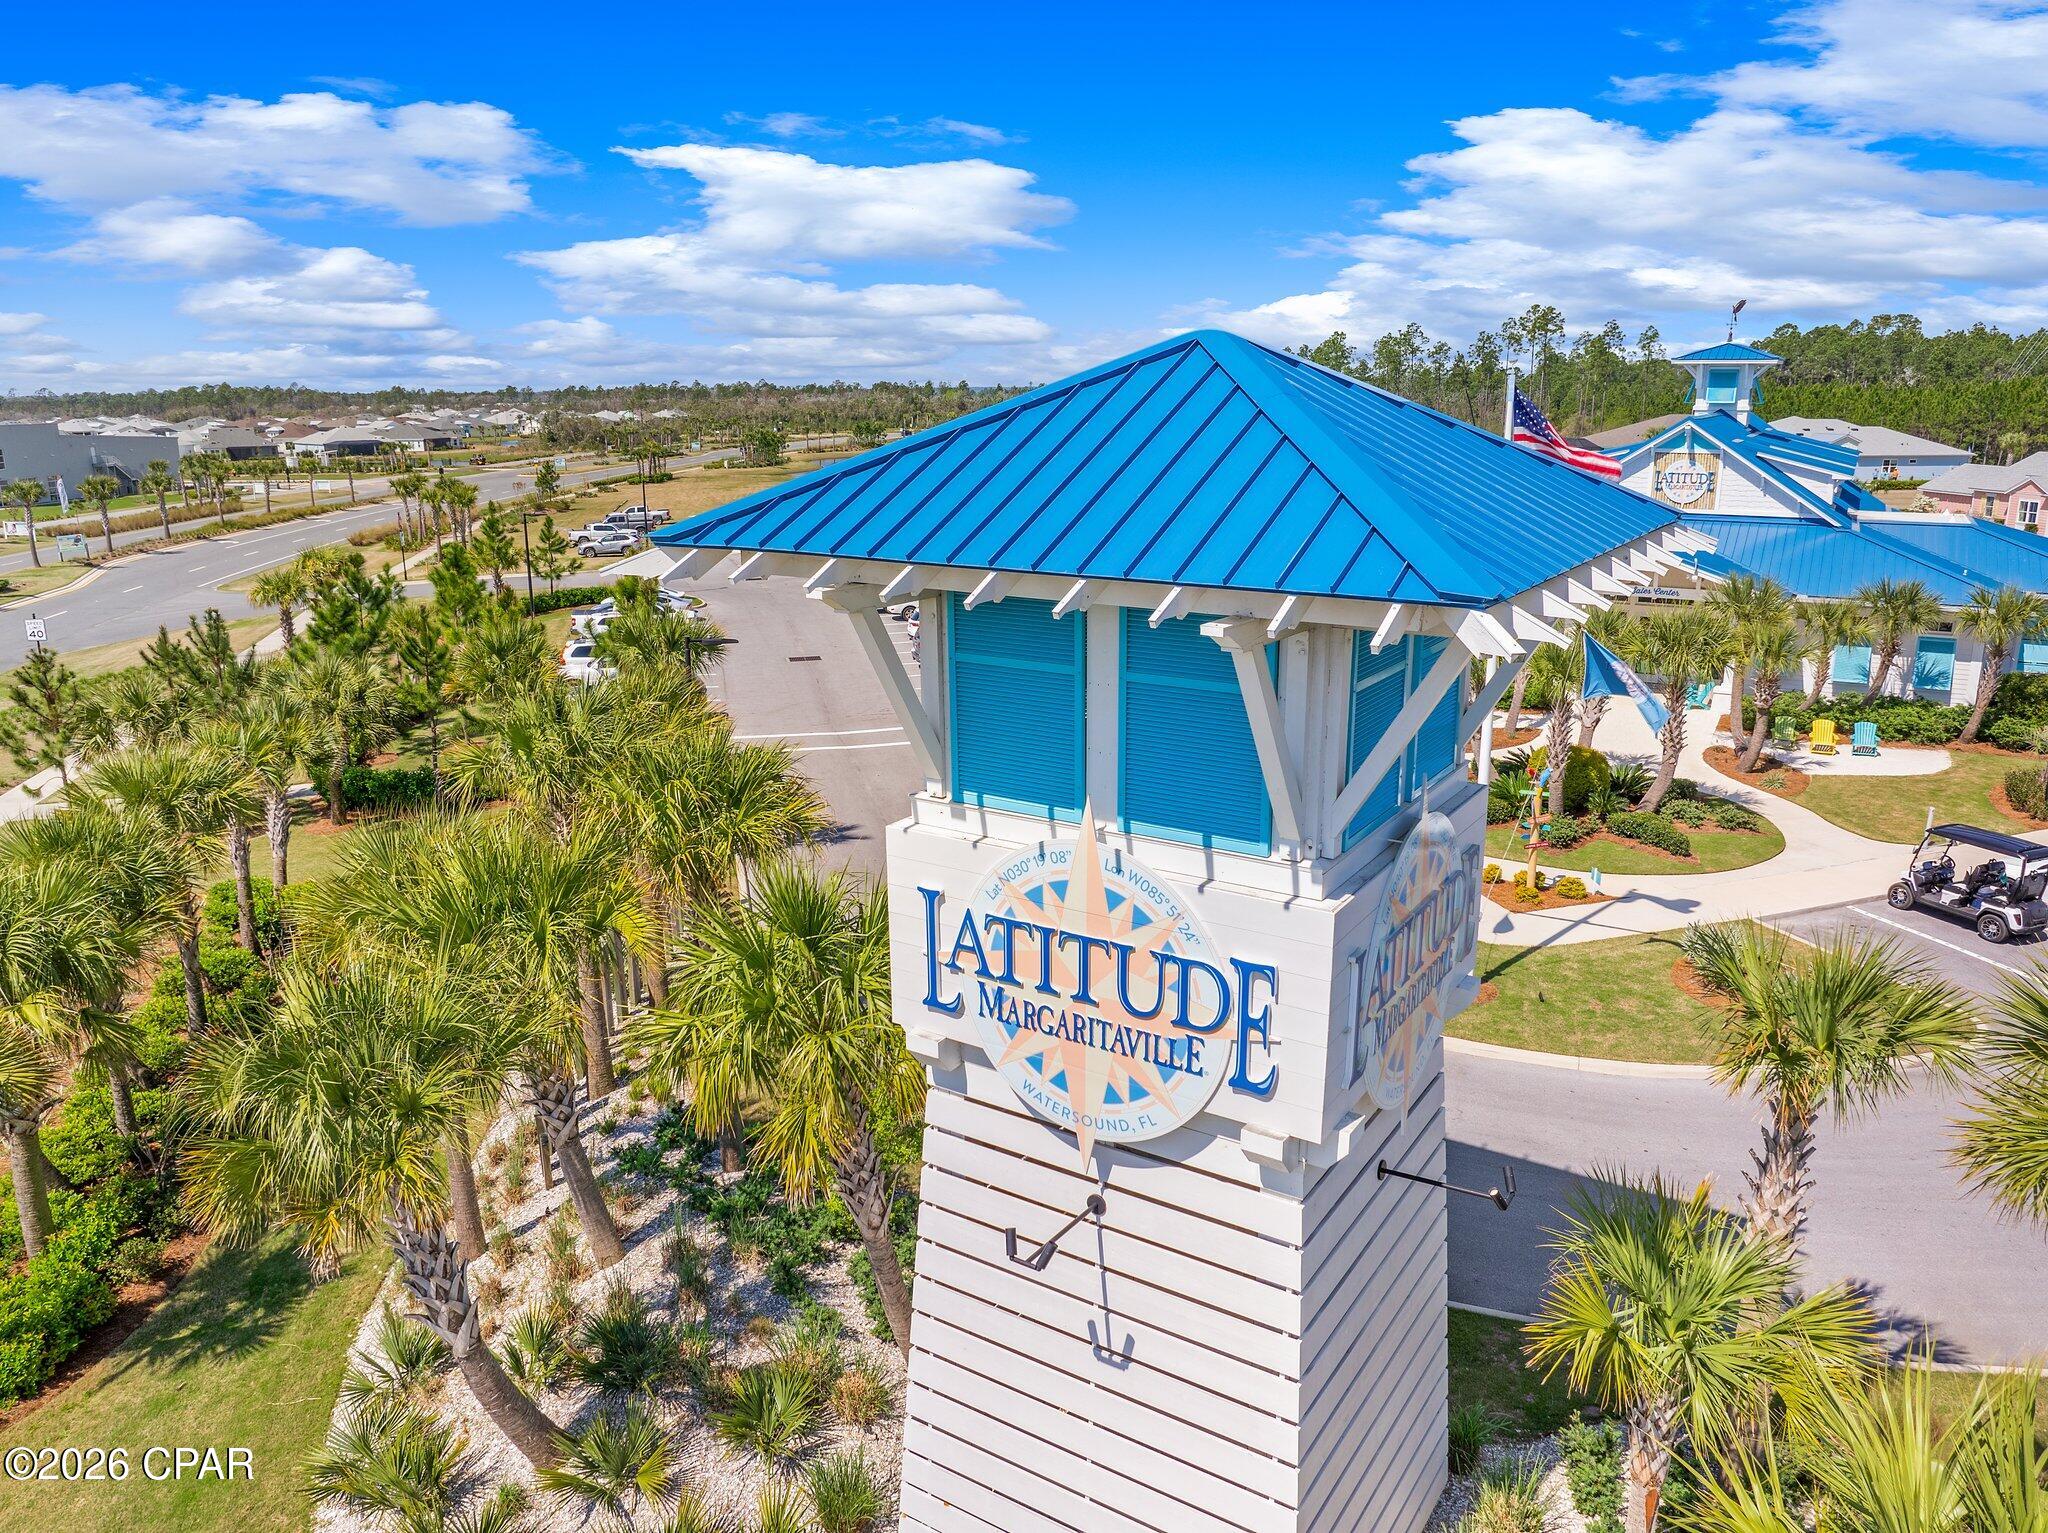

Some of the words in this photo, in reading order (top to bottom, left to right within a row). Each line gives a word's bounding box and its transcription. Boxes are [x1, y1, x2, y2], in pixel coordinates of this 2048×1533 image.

[1655, 470, 1715, 492] LATITUDE
[1654, 588, 1681, 597] Center
[29, 630, 44, 638] 40
[1104, 857, 1125, 878] Lon
[985, 883, 1002, 901] Lat
[1343, 844, 1480, 1090] LATITUDE
[916, 885, 1278, 1097] LATITUDE
[977, 981, 1206, 1078] MARGARITAVILLE
[1022, 1078, 1136, 1134] WATERSOUND,
[1138, 1114, 1158, 1129] FL
